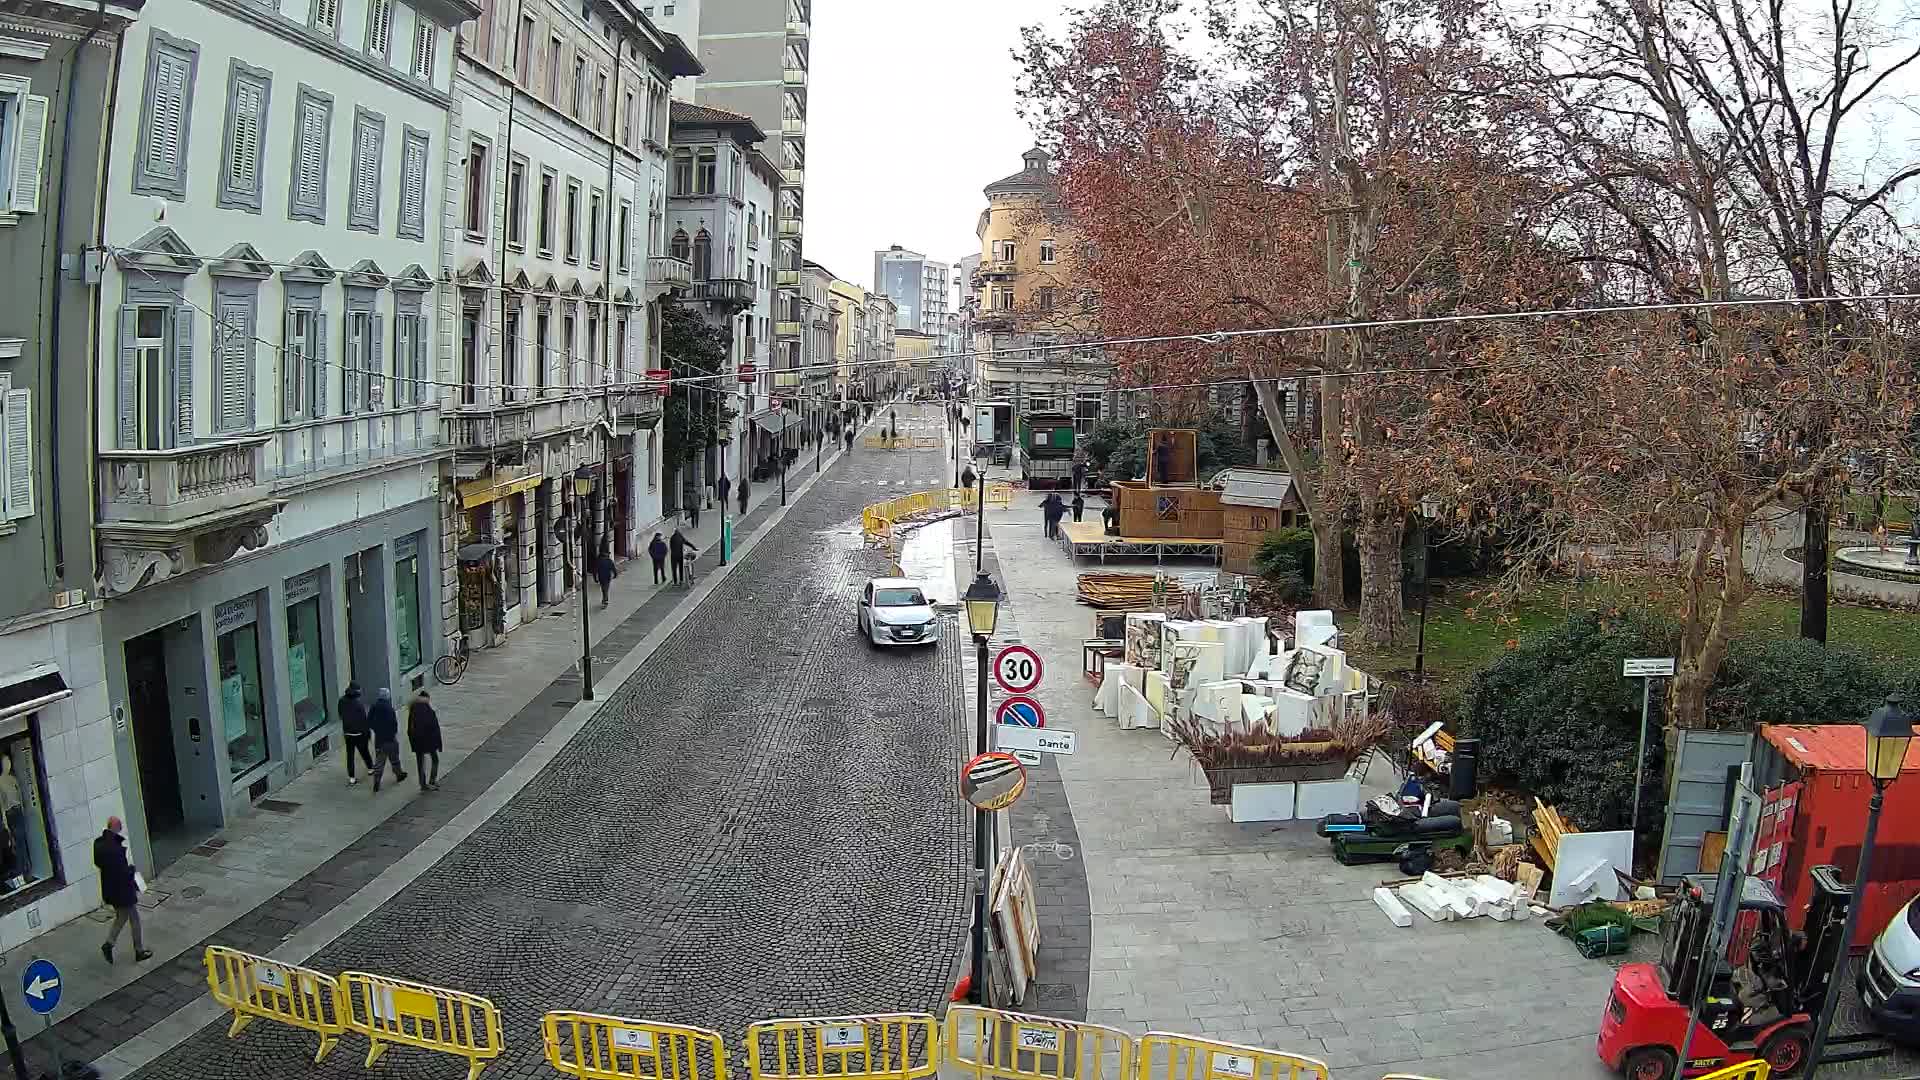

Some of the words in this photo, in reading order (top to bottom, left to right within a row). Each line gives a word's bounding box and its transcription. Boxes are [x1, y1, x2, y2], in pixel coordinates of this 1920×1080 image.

[1005, 658, 1033, 681] 30
[1038, 738, 1070, 750] Dante
[1712, 1019, 1728, 1029] 25
